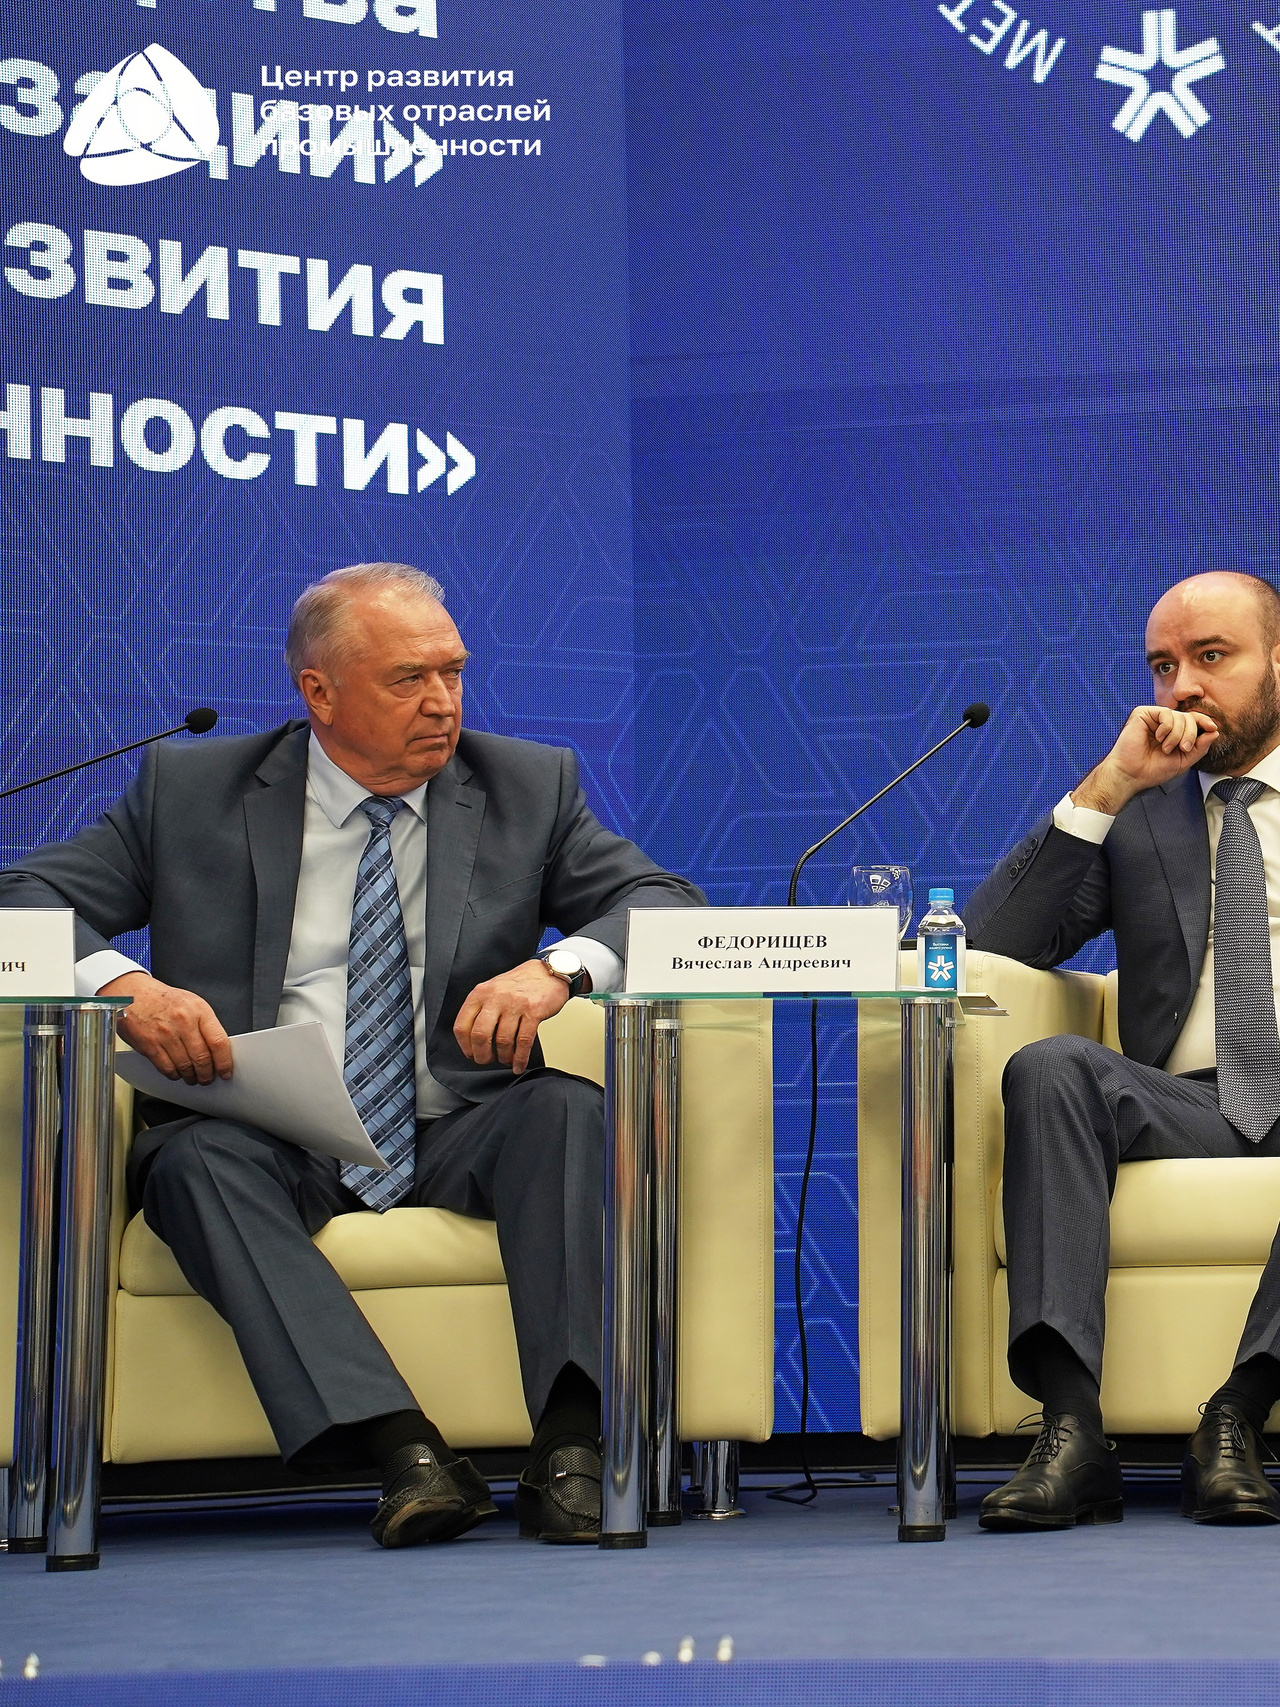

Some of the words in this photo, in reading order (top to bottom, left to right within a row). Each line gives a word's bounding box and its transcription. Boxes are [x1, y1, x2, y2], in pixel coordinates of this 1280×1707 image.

[697, 935, 828, 950] ФЕДОРИЩЕВ
[671, 956, 753, 970] Вячеслав
[758, 956, 851, 973] Андреевич
